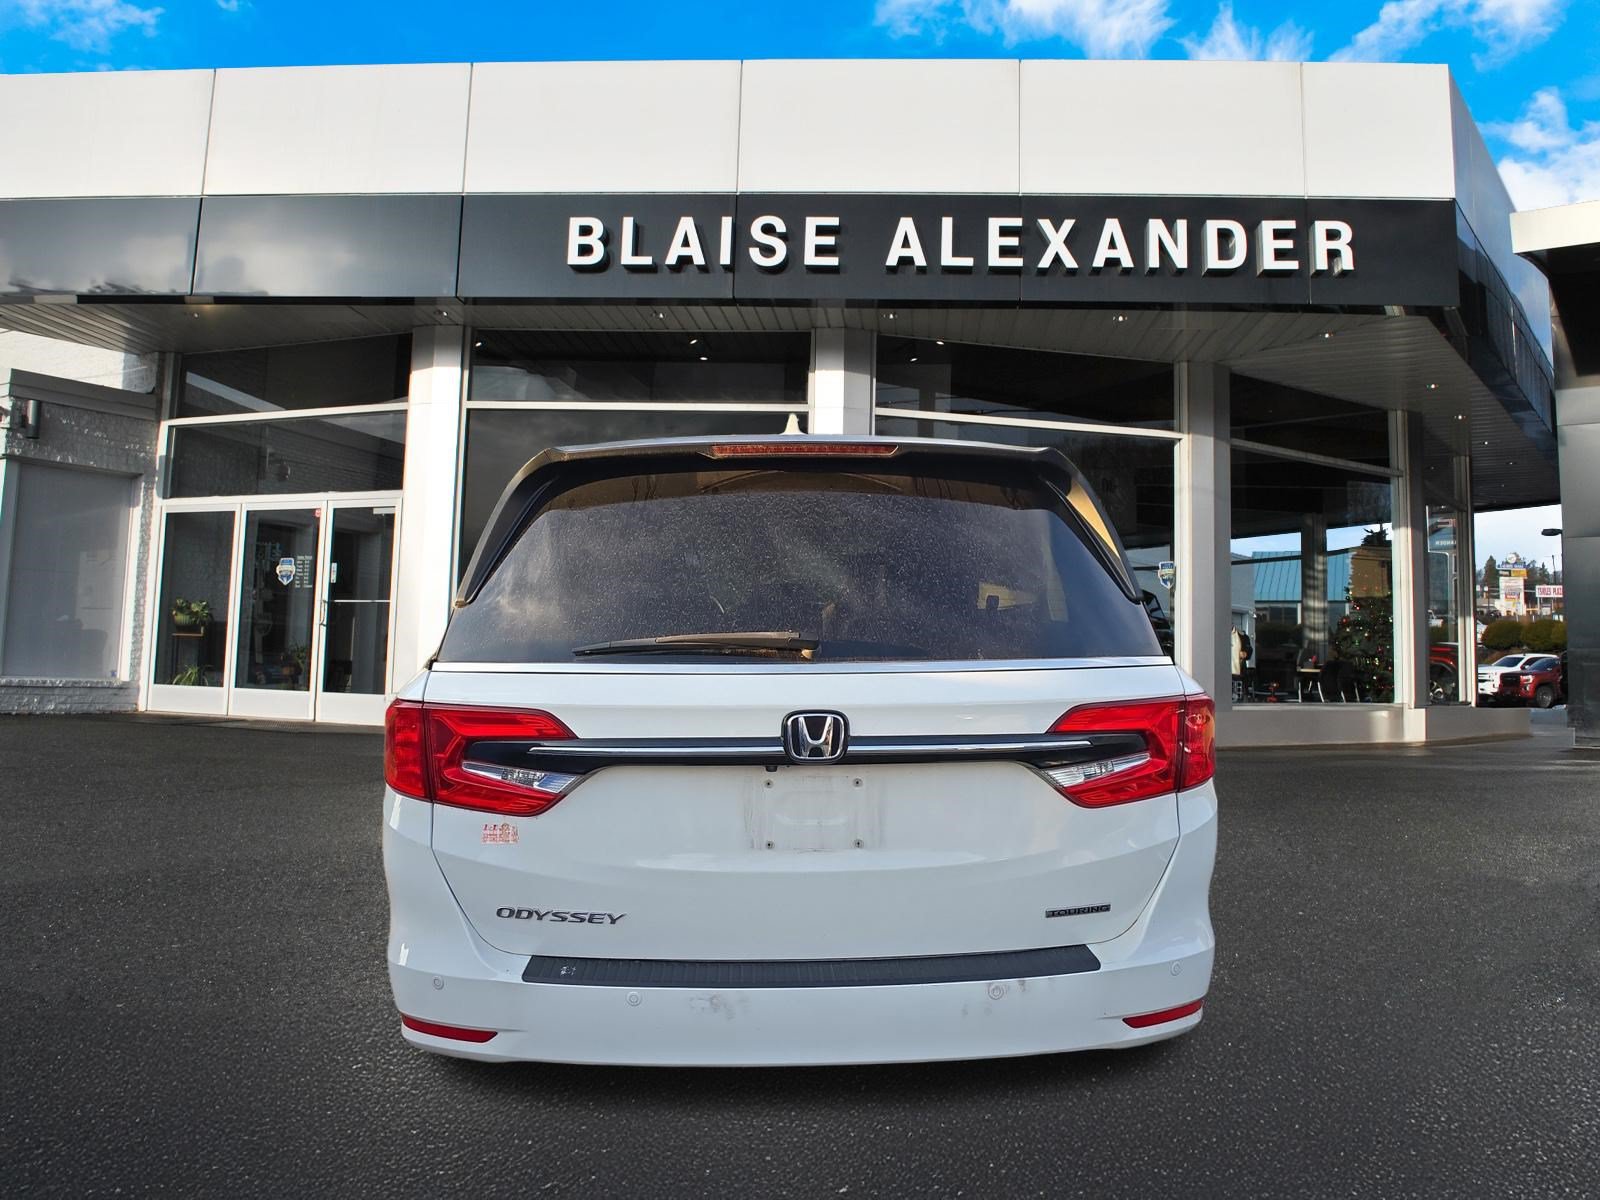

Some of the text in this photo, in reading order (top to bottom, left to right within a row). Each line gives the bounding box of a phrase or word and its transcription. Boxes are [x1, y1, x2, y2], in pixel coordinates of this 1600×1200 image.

[566, 214, 1355, 273] BLAISE ALEXANDER
[496, 906, 626, 925] ODYSSEY
[1048, 904, 1110, 917] TOURING
